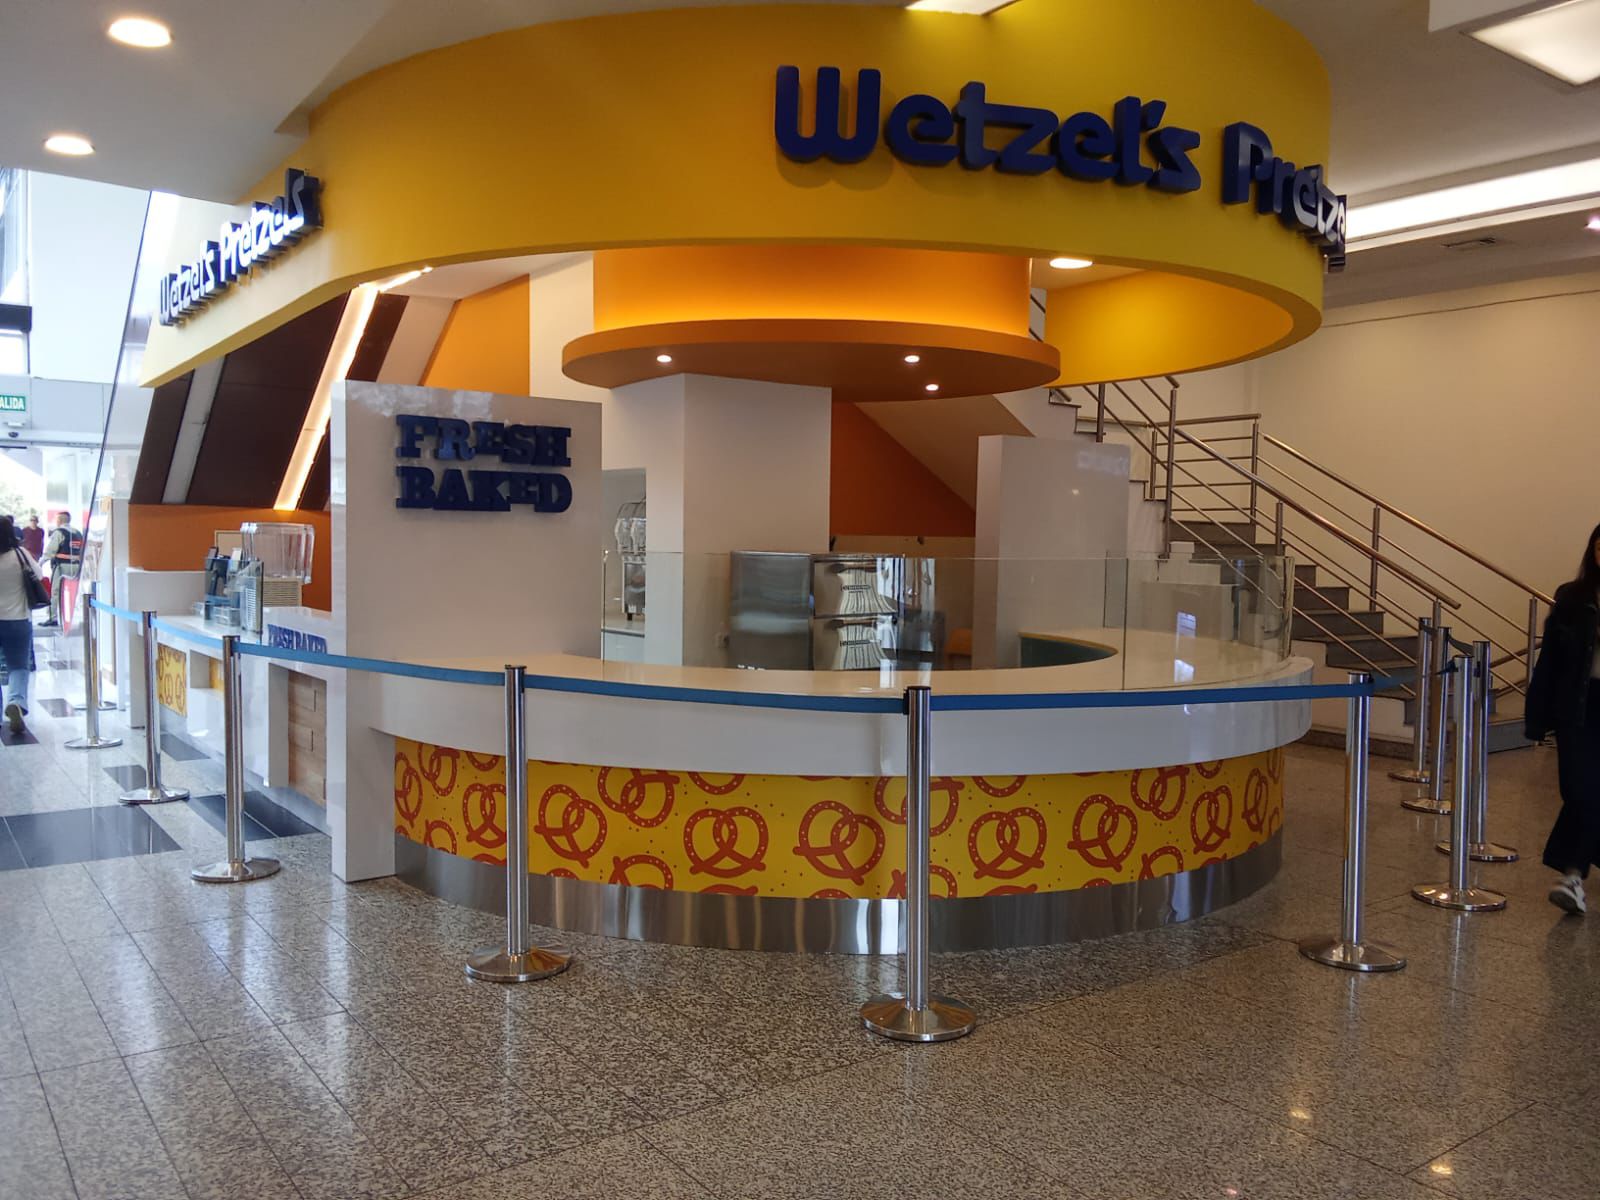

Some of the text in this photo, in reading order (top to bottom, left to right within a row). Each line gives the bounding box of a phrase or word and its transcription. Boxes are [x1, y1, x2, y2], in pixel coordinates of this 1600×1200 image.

[775, 64, 1201, 195] Wetzel's
[0, 395, 25, 410] ALIDA
[396, 414, 572, 467] FRESH
[396, 465, 573, 513] BAKED
